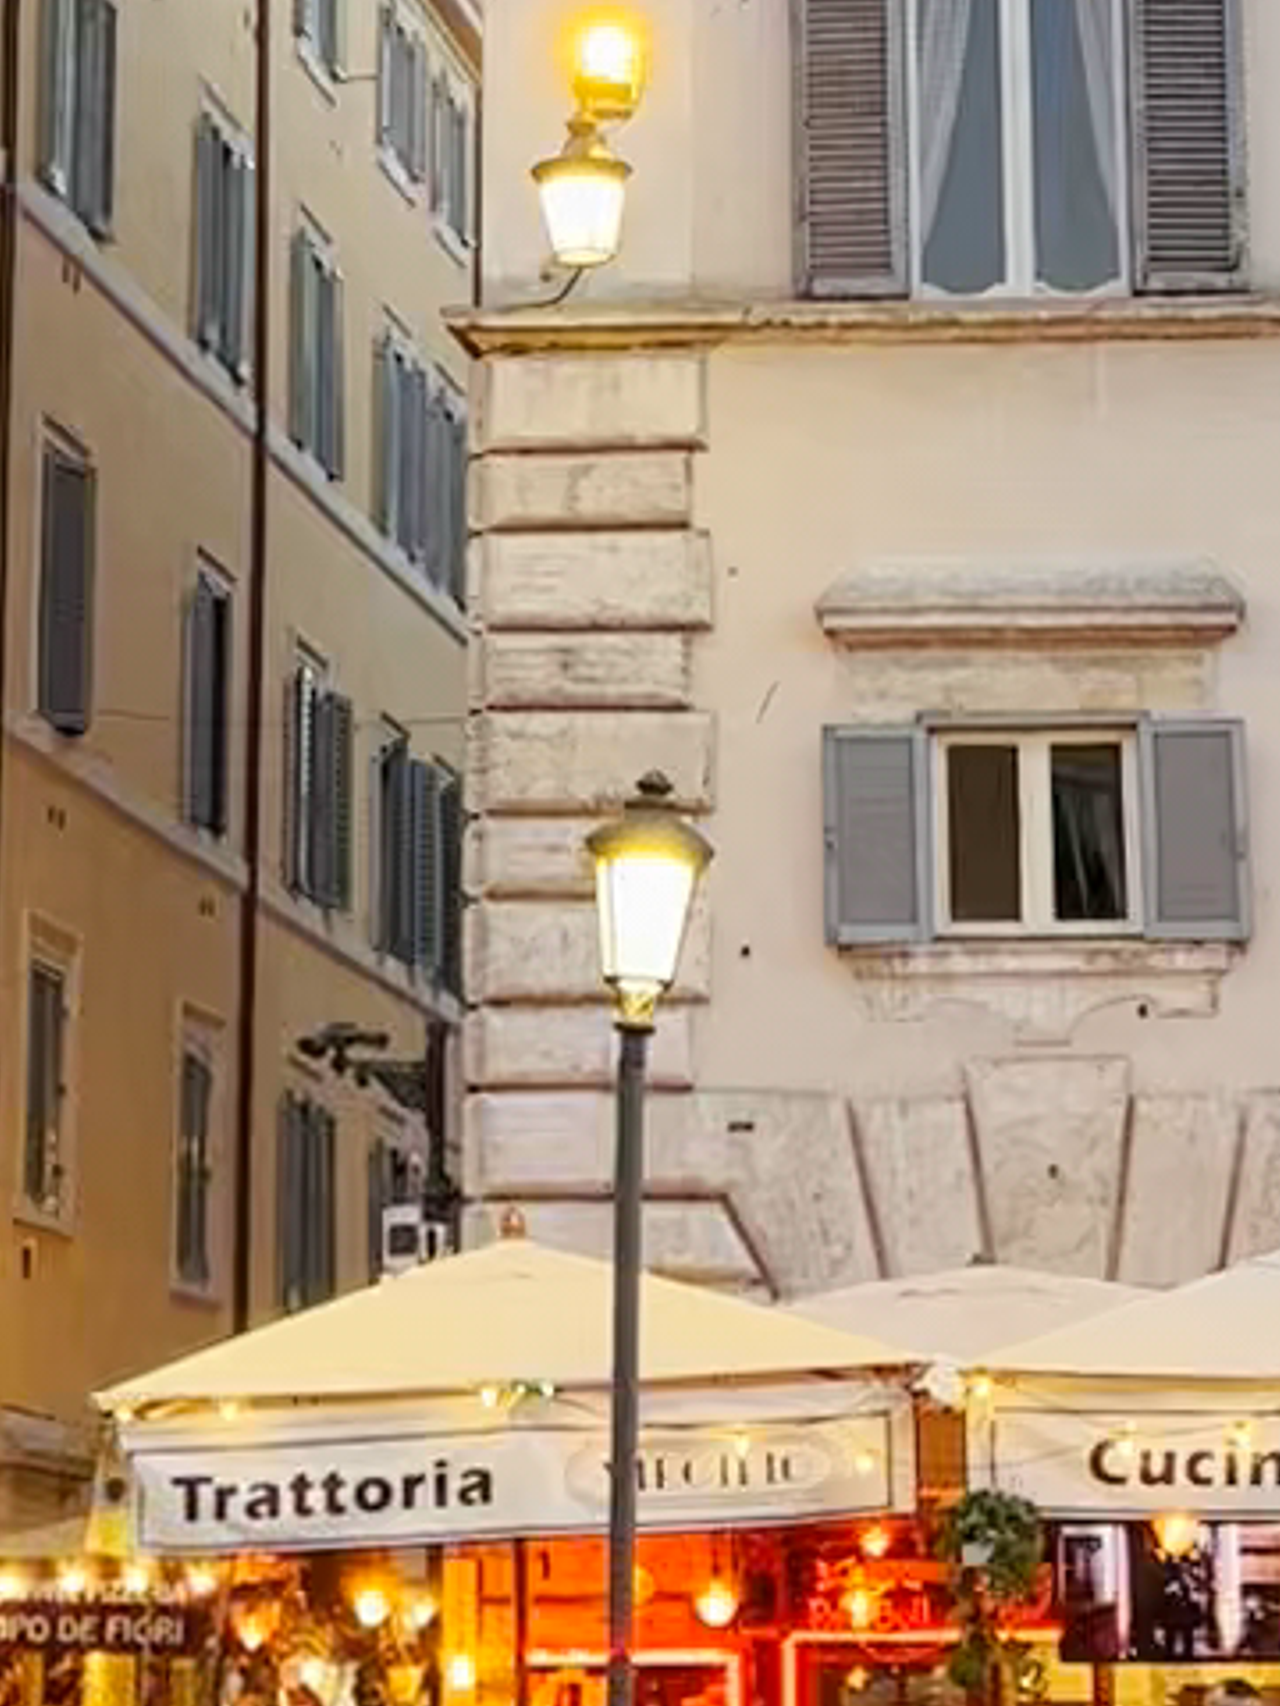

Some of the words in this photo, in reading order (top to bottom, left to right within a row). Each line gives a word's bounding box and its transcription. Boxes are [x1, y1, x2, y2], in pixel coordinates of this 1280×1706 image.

[171, 1458, 494, 1523] Trattoria
[57, 1614, 100, 1644] DE
[104, 1614, 186, 1646] FIORI
